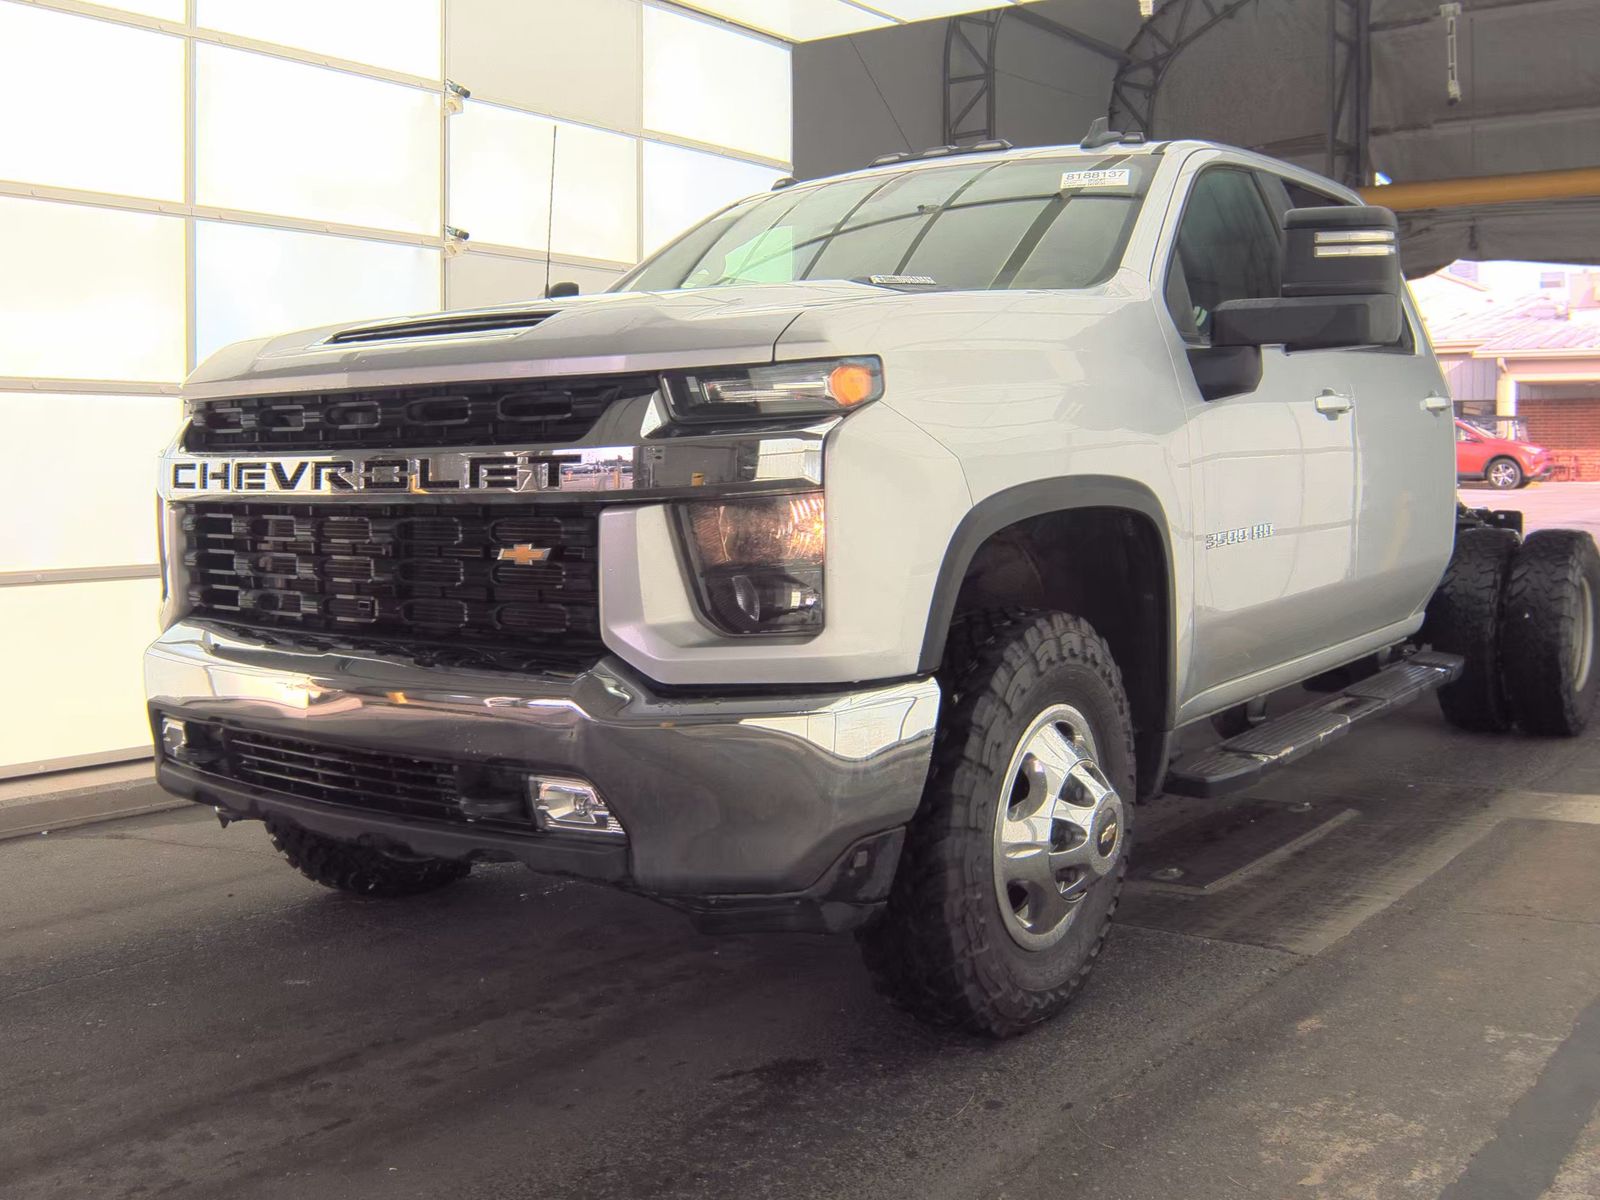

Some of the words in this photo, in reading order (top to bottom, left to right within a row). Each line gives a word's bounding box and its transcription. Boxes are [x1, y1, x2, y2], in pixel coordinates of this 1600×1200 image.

[1066, 170, 1125, 180] 8188137
[172, 454, 583, 491] CHEVROLET
[1205, 527, 1247, 550] 3500
